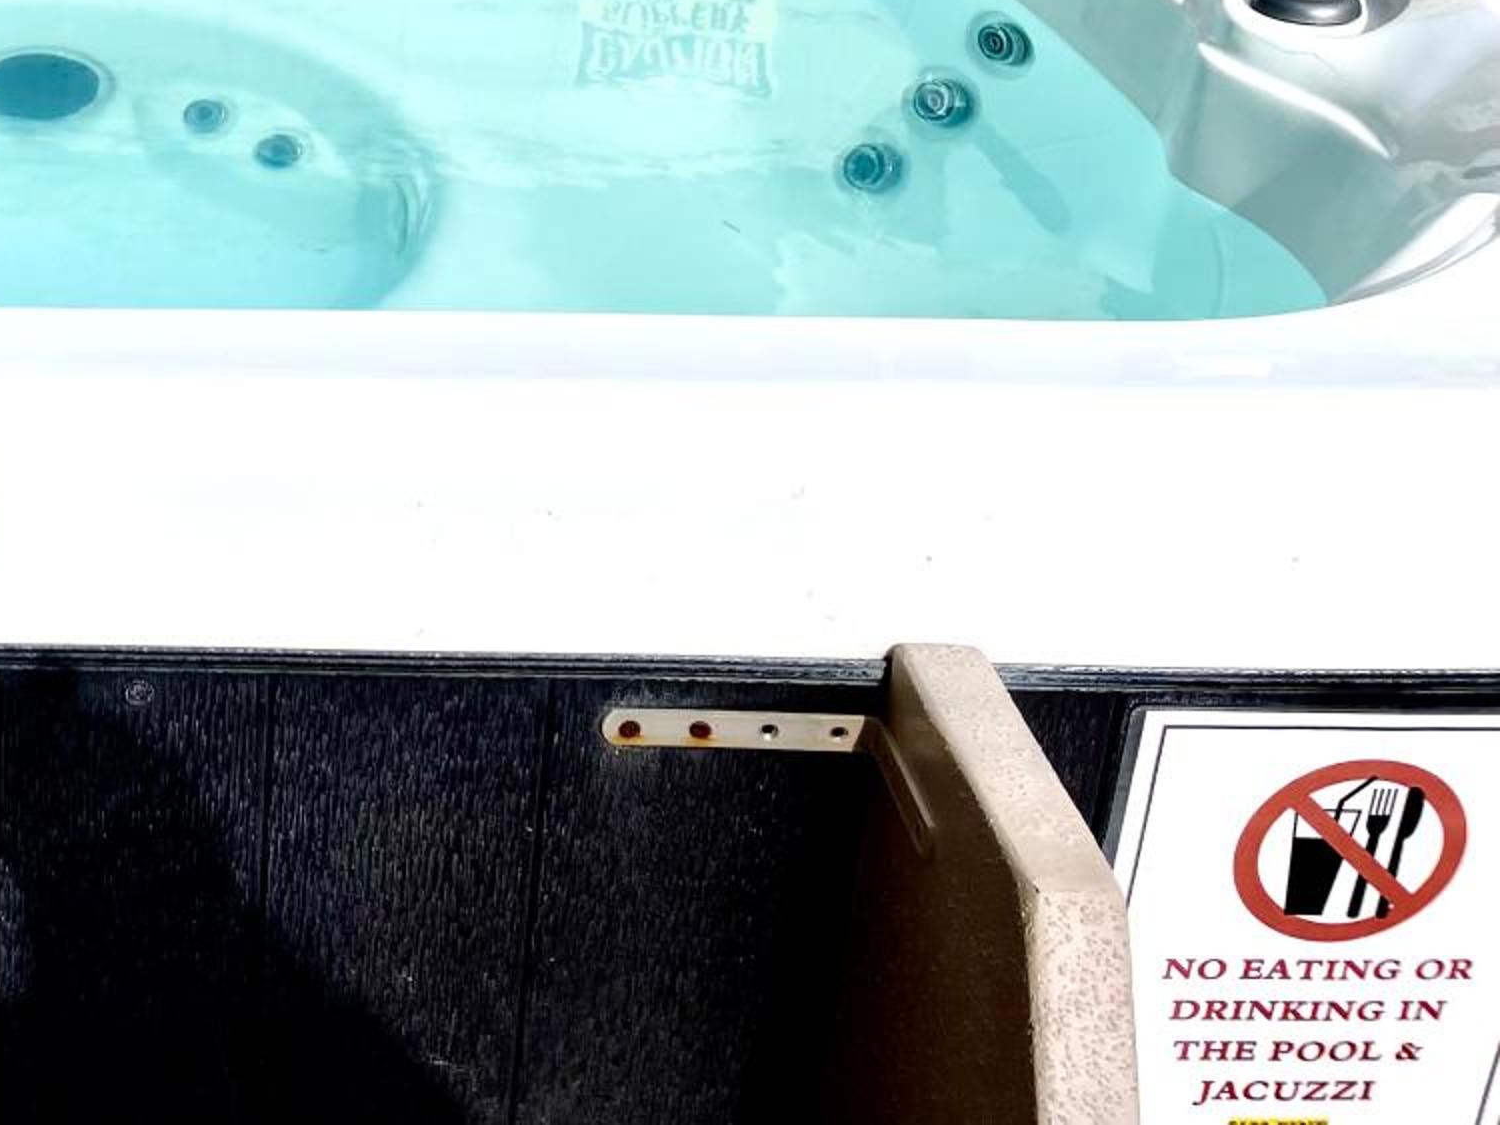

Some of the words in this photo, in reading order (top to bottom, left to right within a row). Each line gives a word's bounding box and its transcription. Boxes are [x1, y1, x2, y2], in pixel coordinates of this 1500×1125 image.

[1162, 958, 1227, 980] NO
[1239, 958, 1400, 980] EATING
[1415, 958, 1473, 980] OR
[1169, 999, 1386, 1021] DRINKING
[1396, 999, 1447, 1021] IN
[1172, 1040, 1257, 1062] THE
[1269, 1040, 1381, 1062] POOL
[1395, 1041, 1424, 1061] &
[1192, 1079, 1376, 1106] JACUZZI
